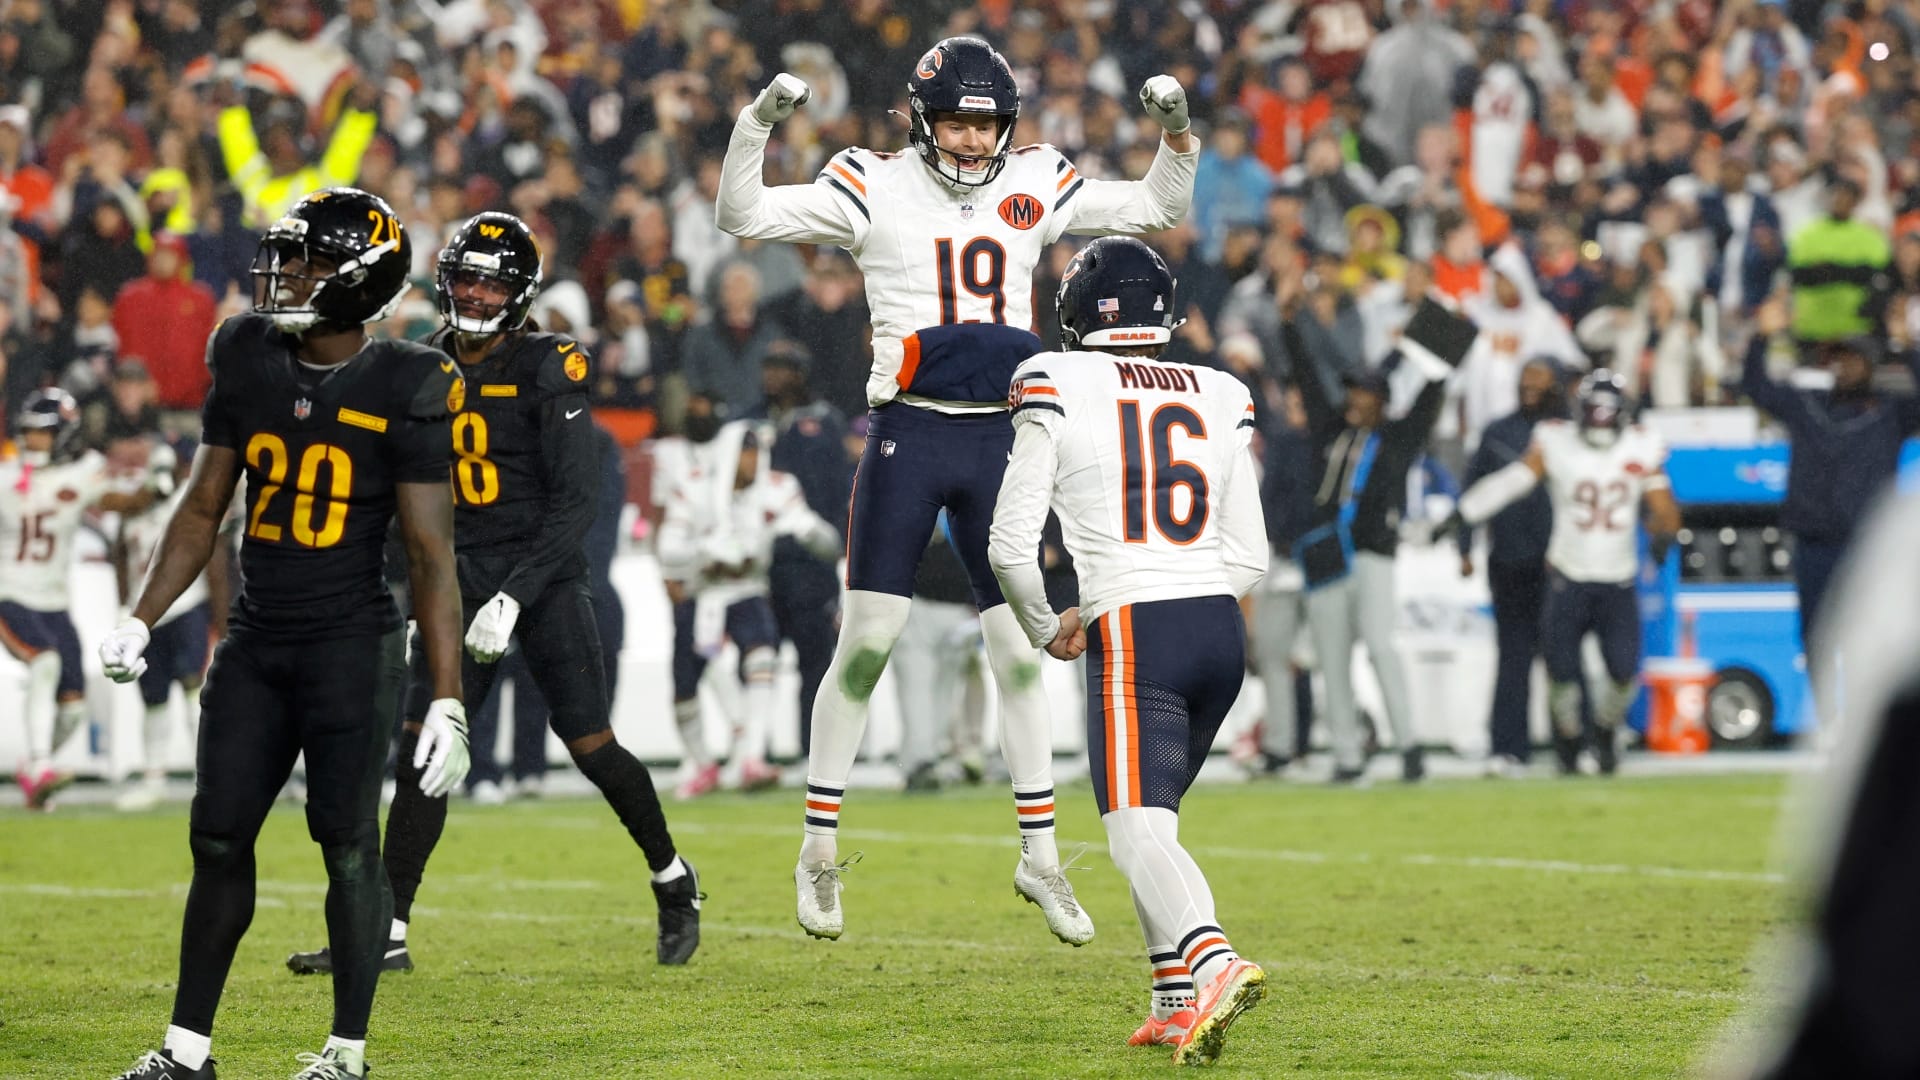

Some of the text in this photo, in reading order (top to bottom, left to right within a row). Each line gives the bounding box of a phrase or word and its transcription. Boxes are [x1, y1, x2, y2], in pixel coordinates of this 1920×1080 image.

[368, 209, 401, 253] 20
[934, 235, 1007, 326] 19
[1109, 332, 1156, 342] BEARS
[1114, 361, 1202, 393] MOODY
[450, 411, 500, 507] 8
[1116, 399, 1210, 546] 16
[245, 431, 353, 549] 20
[1572, 478, 1630, 533] 92
[16, 508, 58, 562] 15
